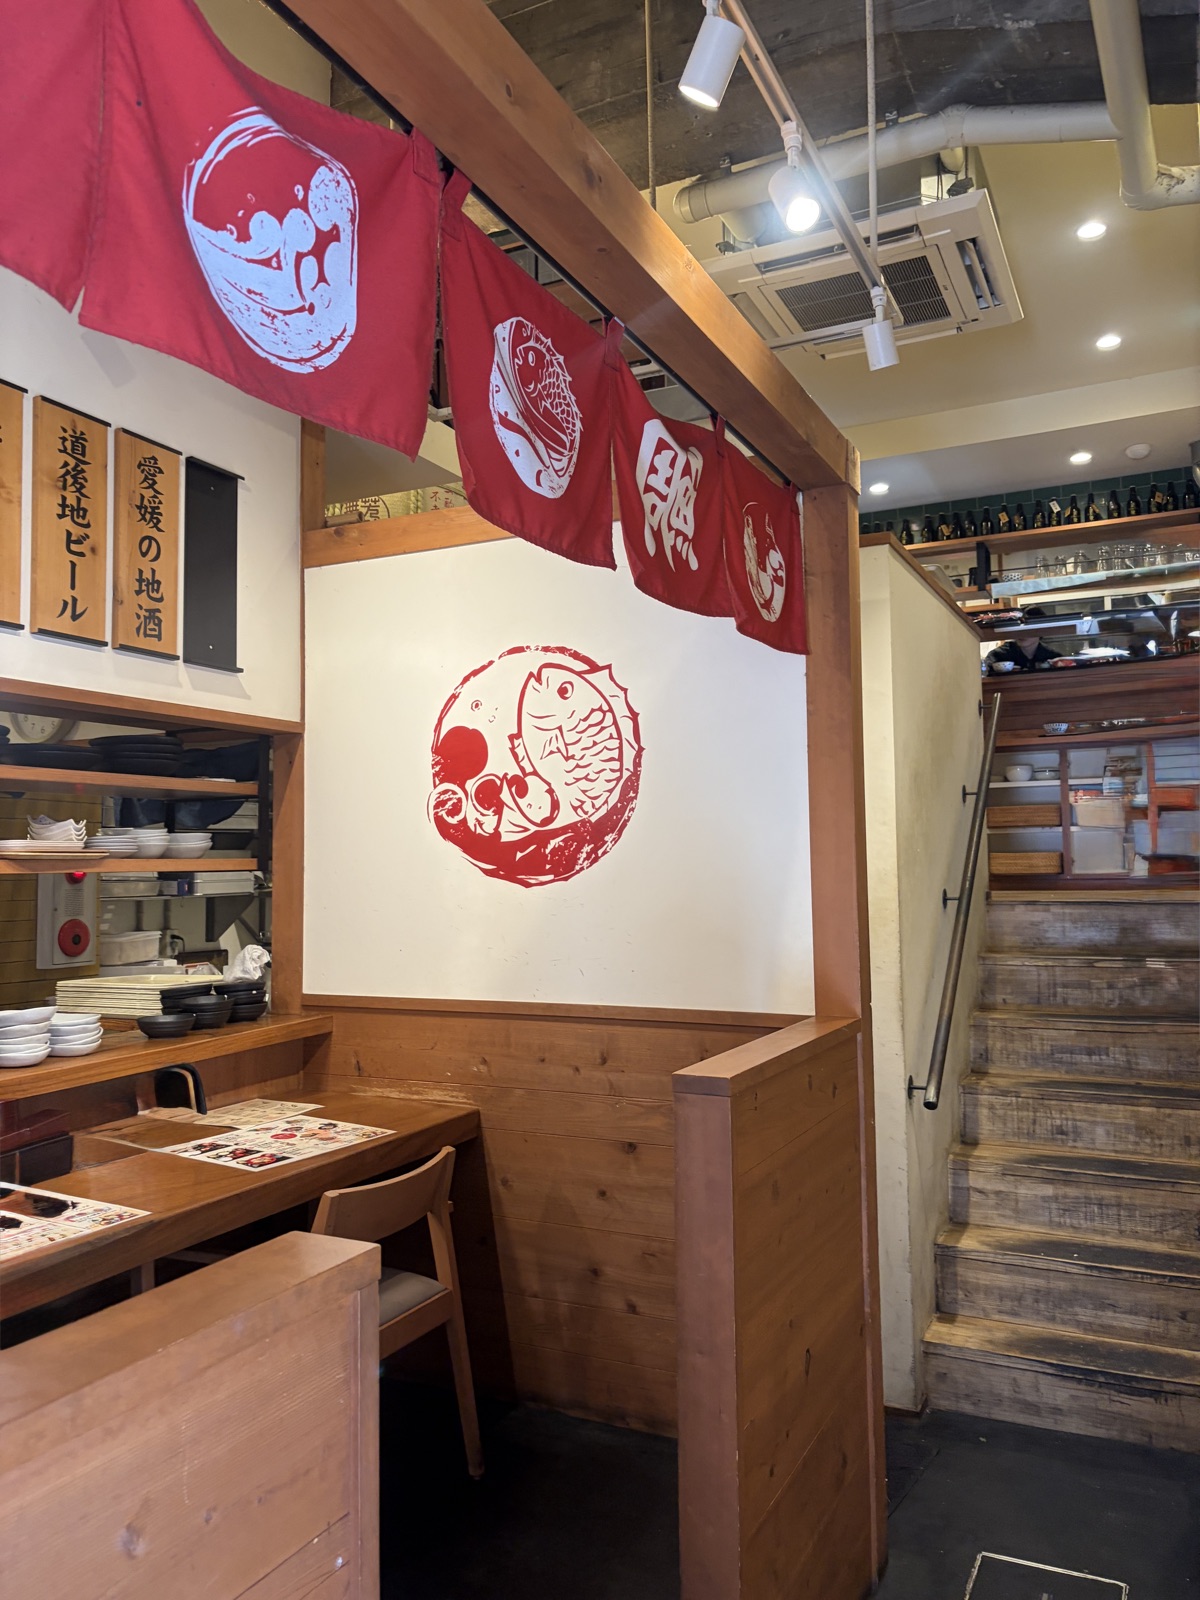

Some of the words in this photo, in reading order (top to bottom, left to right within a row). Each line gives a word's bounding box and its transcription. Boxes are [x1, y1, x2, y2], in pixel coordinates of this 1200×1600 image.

[56, 425, 93, 623] 道後地ビール
[135, 454, 166, 643] 愛媛の地酒
